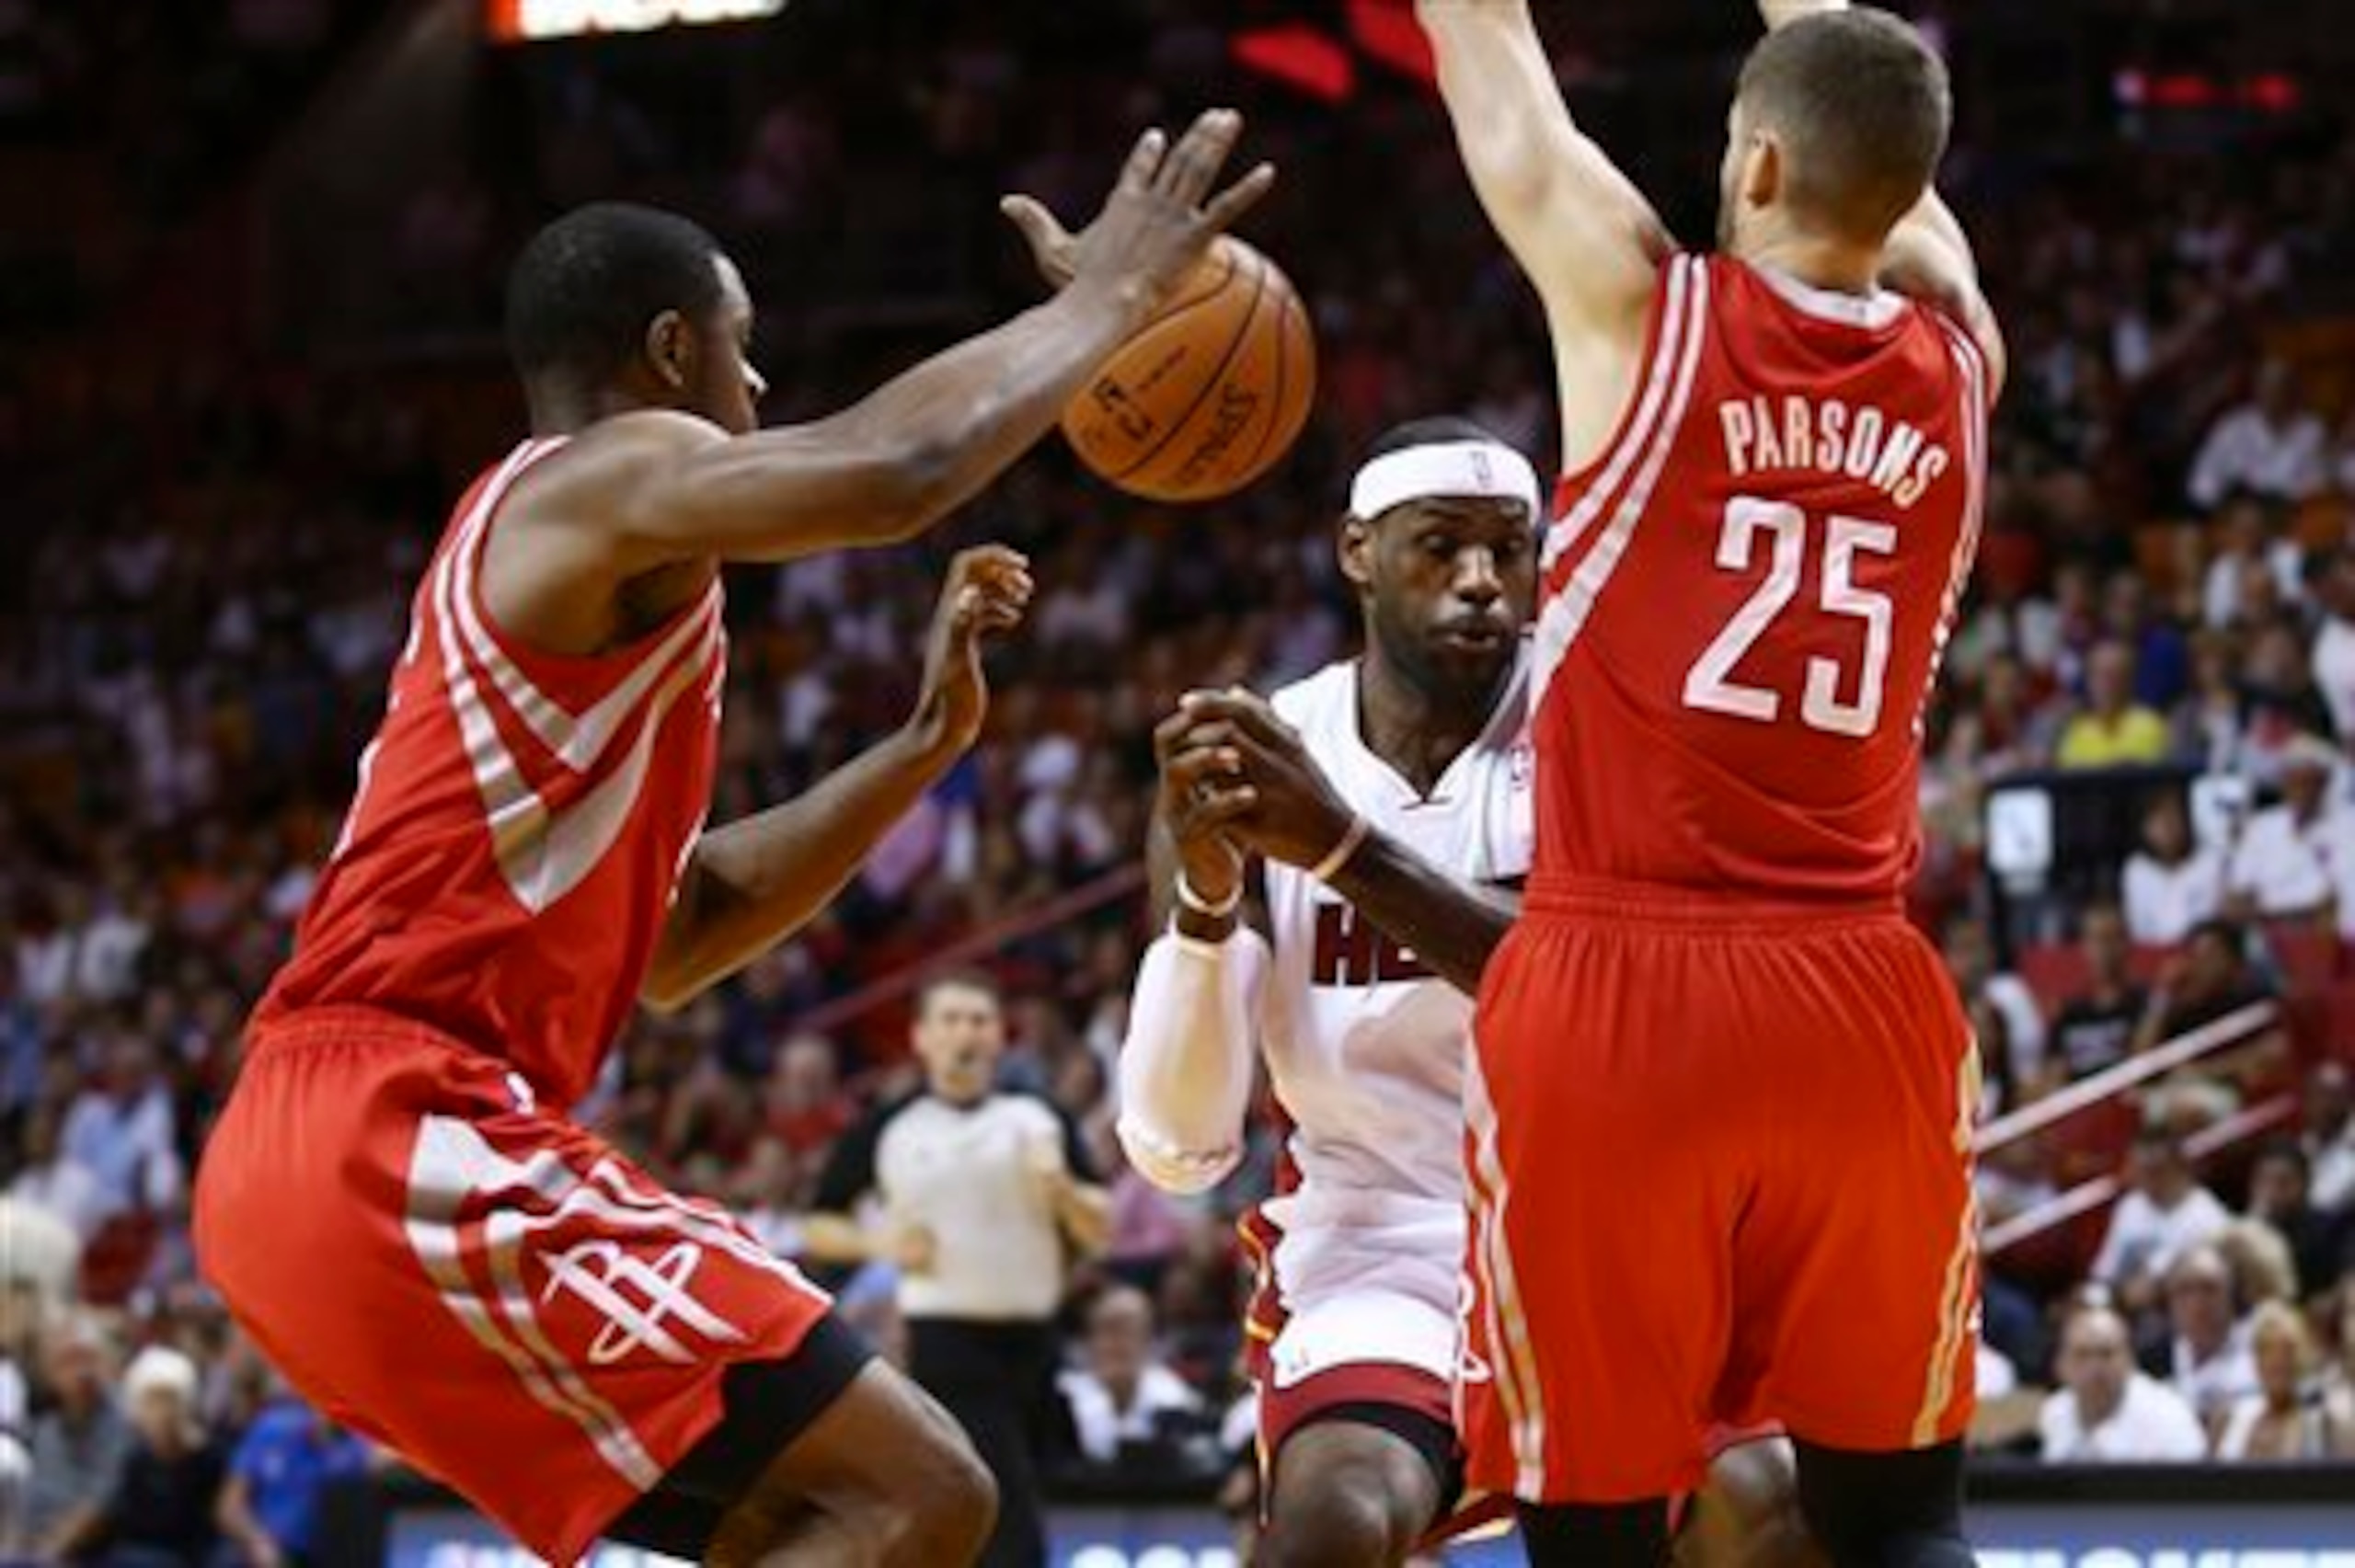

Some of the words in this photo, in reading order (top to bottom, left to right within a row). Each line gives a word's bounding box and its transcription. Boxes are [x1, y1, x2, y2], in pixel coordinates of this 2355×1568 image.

[1718, 394, 1948, 508] PARSONS
[1683, 494, 1897, 736] 25
[1312, 902, 1438, 984] HE
